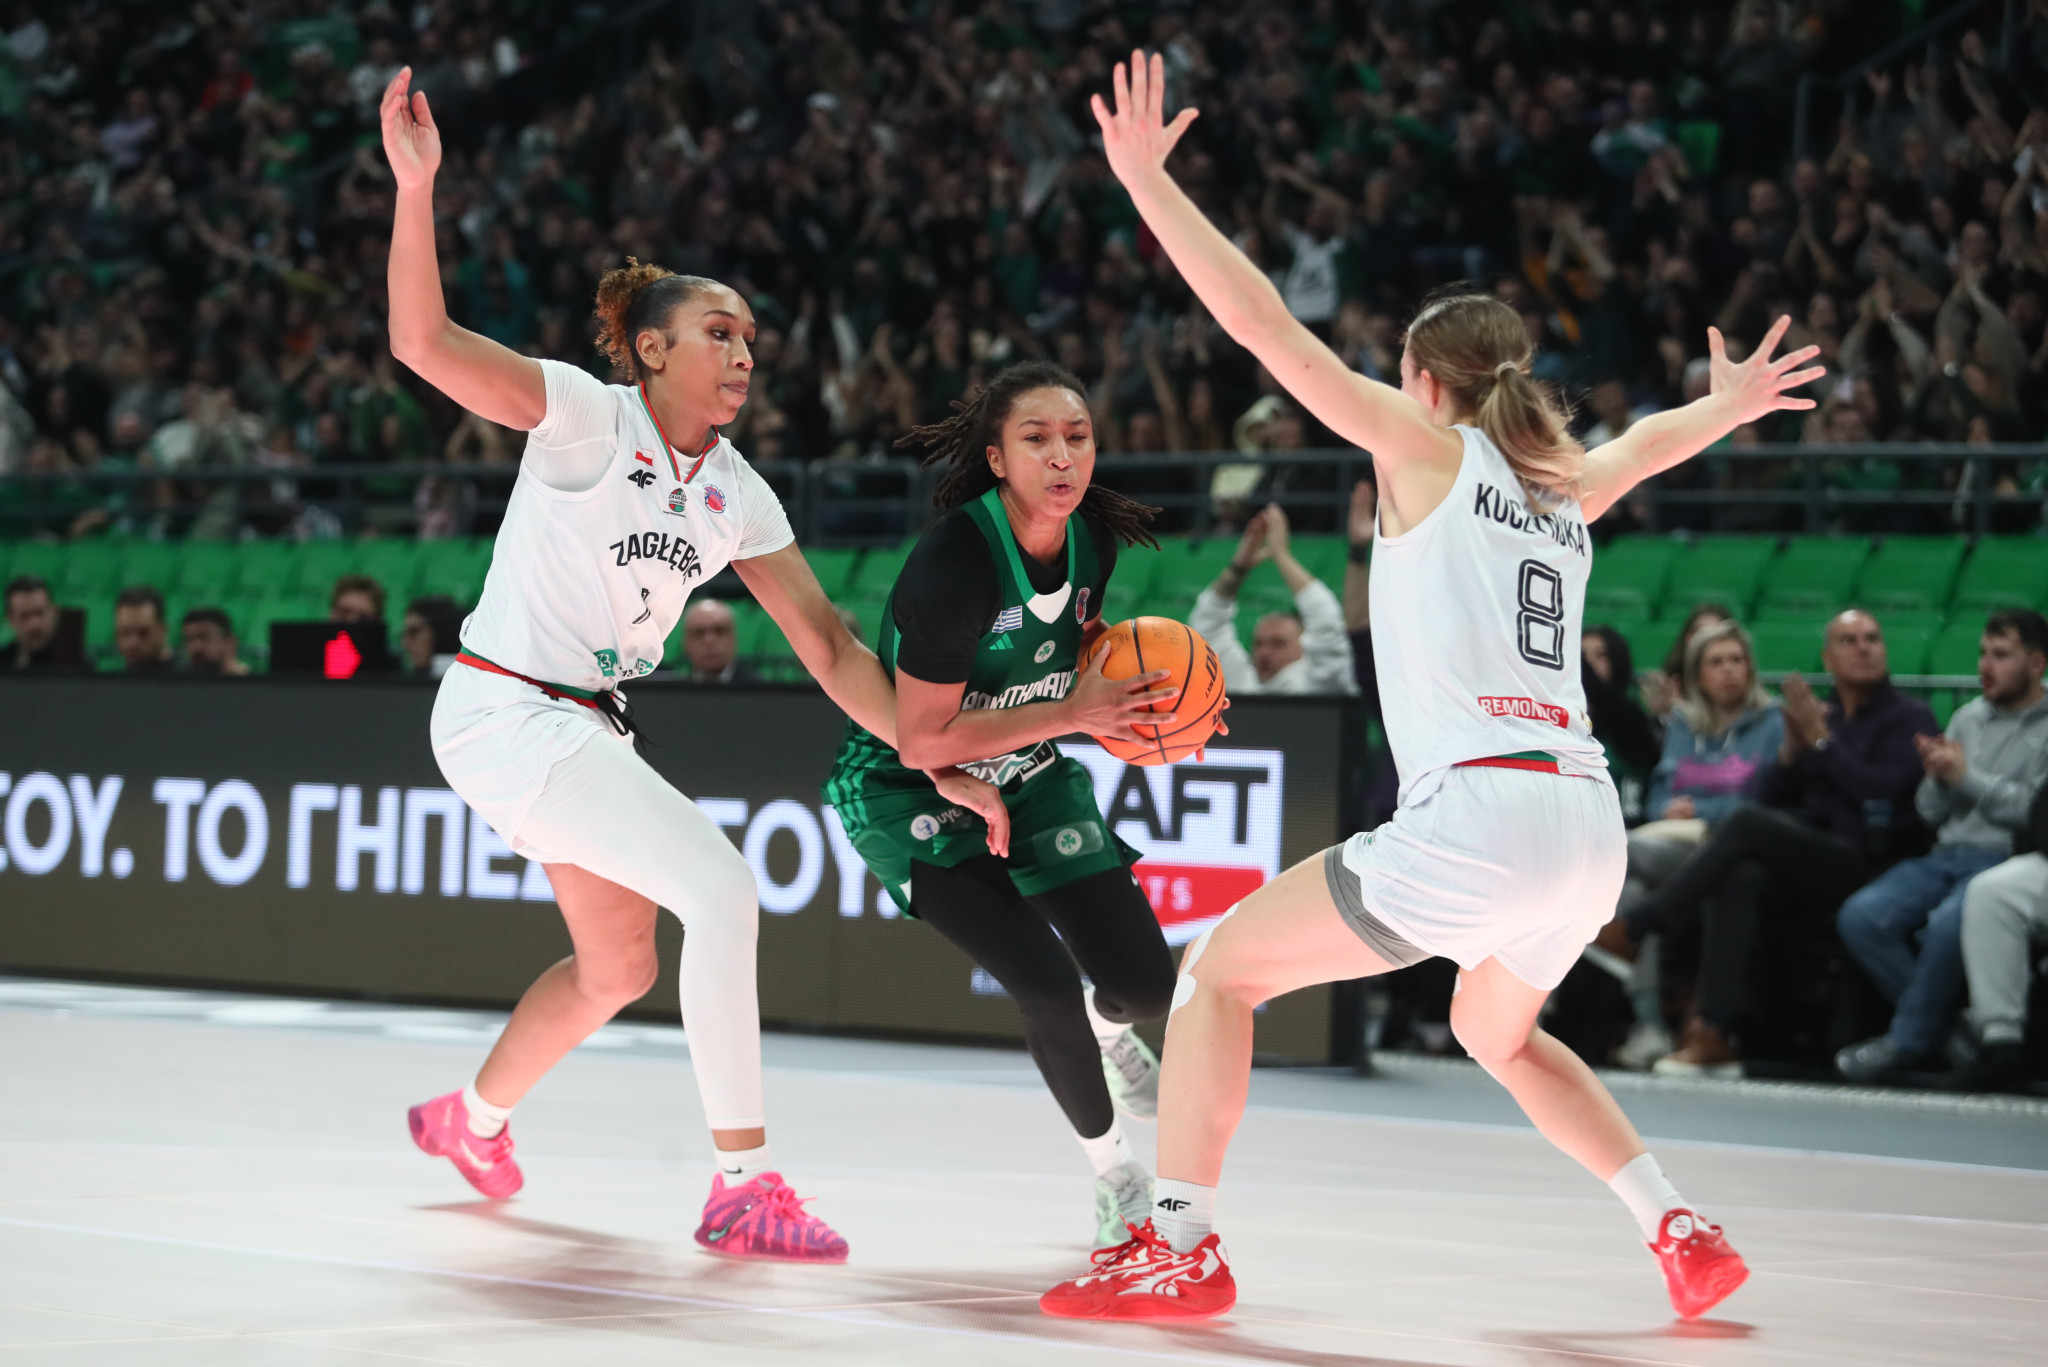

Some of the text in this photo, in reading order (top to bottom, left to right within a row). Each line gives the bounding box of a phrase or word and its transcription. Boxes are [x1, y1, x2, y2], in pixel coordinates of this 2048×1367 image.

[1517, 559, 1564, 671] 8
[0, 770, 134, 878] ΟΥ.
[152, 777, 269, 886] ΤΟ
[1104, 764, 1269, 845] AFT
